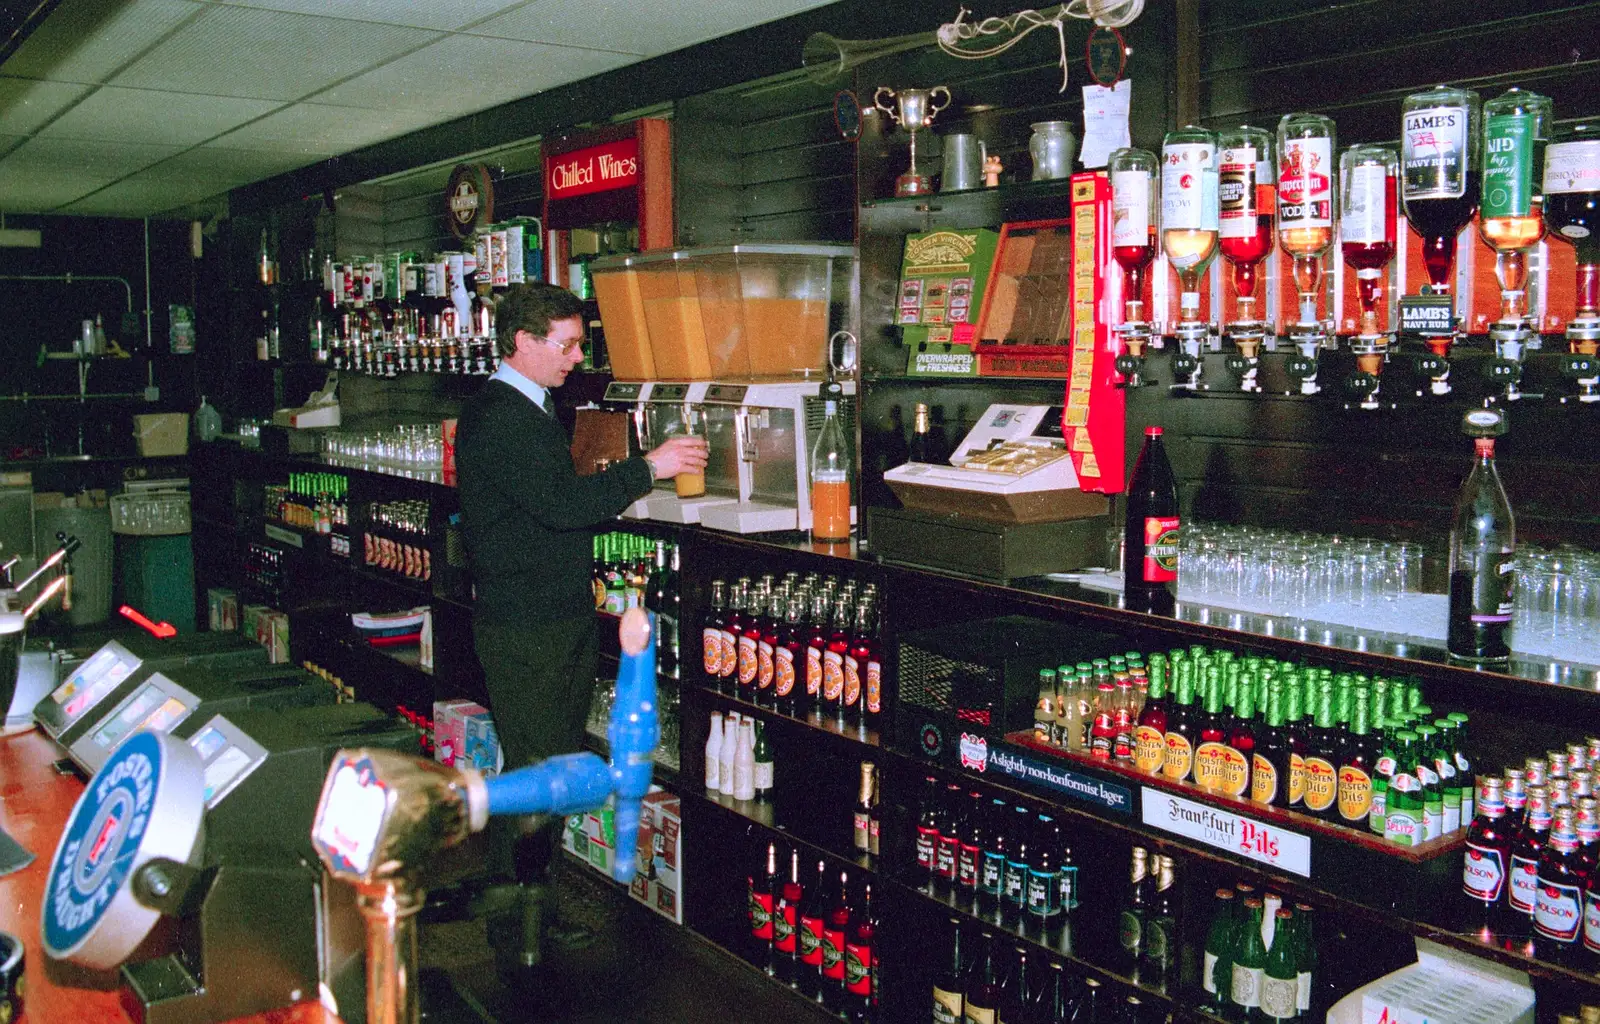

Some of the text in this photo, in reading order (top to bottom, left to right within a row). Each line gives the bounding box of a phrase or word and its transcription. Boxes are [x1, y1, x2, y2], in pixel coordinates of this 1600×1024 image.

[1407, 115, 1455, 130] LAMB'S
[1487, 137, 1514, 153] GIN
[1407, 158, 1456, 168] NAVY RUM
[552, 154, 637, 190] Chilled Wines
[1282, 204, 1317, 217] VODA
[909, 235, 969, 258] GOLDEN VIRGINIA
[1403, 307, 1449, 319] LAMB'S
[1403, 320, 1449, 329] NAVY RUM
[916, 353, 973, 364] OVERWRAPPED
[916, 363, 971, 373] for FRESHNESS
[1294, 362, 1306, 370] 60
[1423, 361, 1437, 369] 60
[1495, 367, 1510, 375] 60
[1572, 362, 1588, 370] 60
[1137, 748, 1156, 759] Pils
[990, 751, 998, 764] A
[998, 753, 1029, 778] slightly
[1028, 767, 1099, 796] non-konformist
[1100, 784, 1125, 805] lager.
[1222, 770, 1238, 782] ils
[1306, 780, 1328, 793] Pils
[97, 752, 153, 840] FOSTER'S
[1340, 790, 1364, 802] Pils
[1168, 799, 1280, 862] Frankfurt Pils
[1466, 865, 1494, 879] OLSON
[1513, 877, 1536, 890] MOLS
